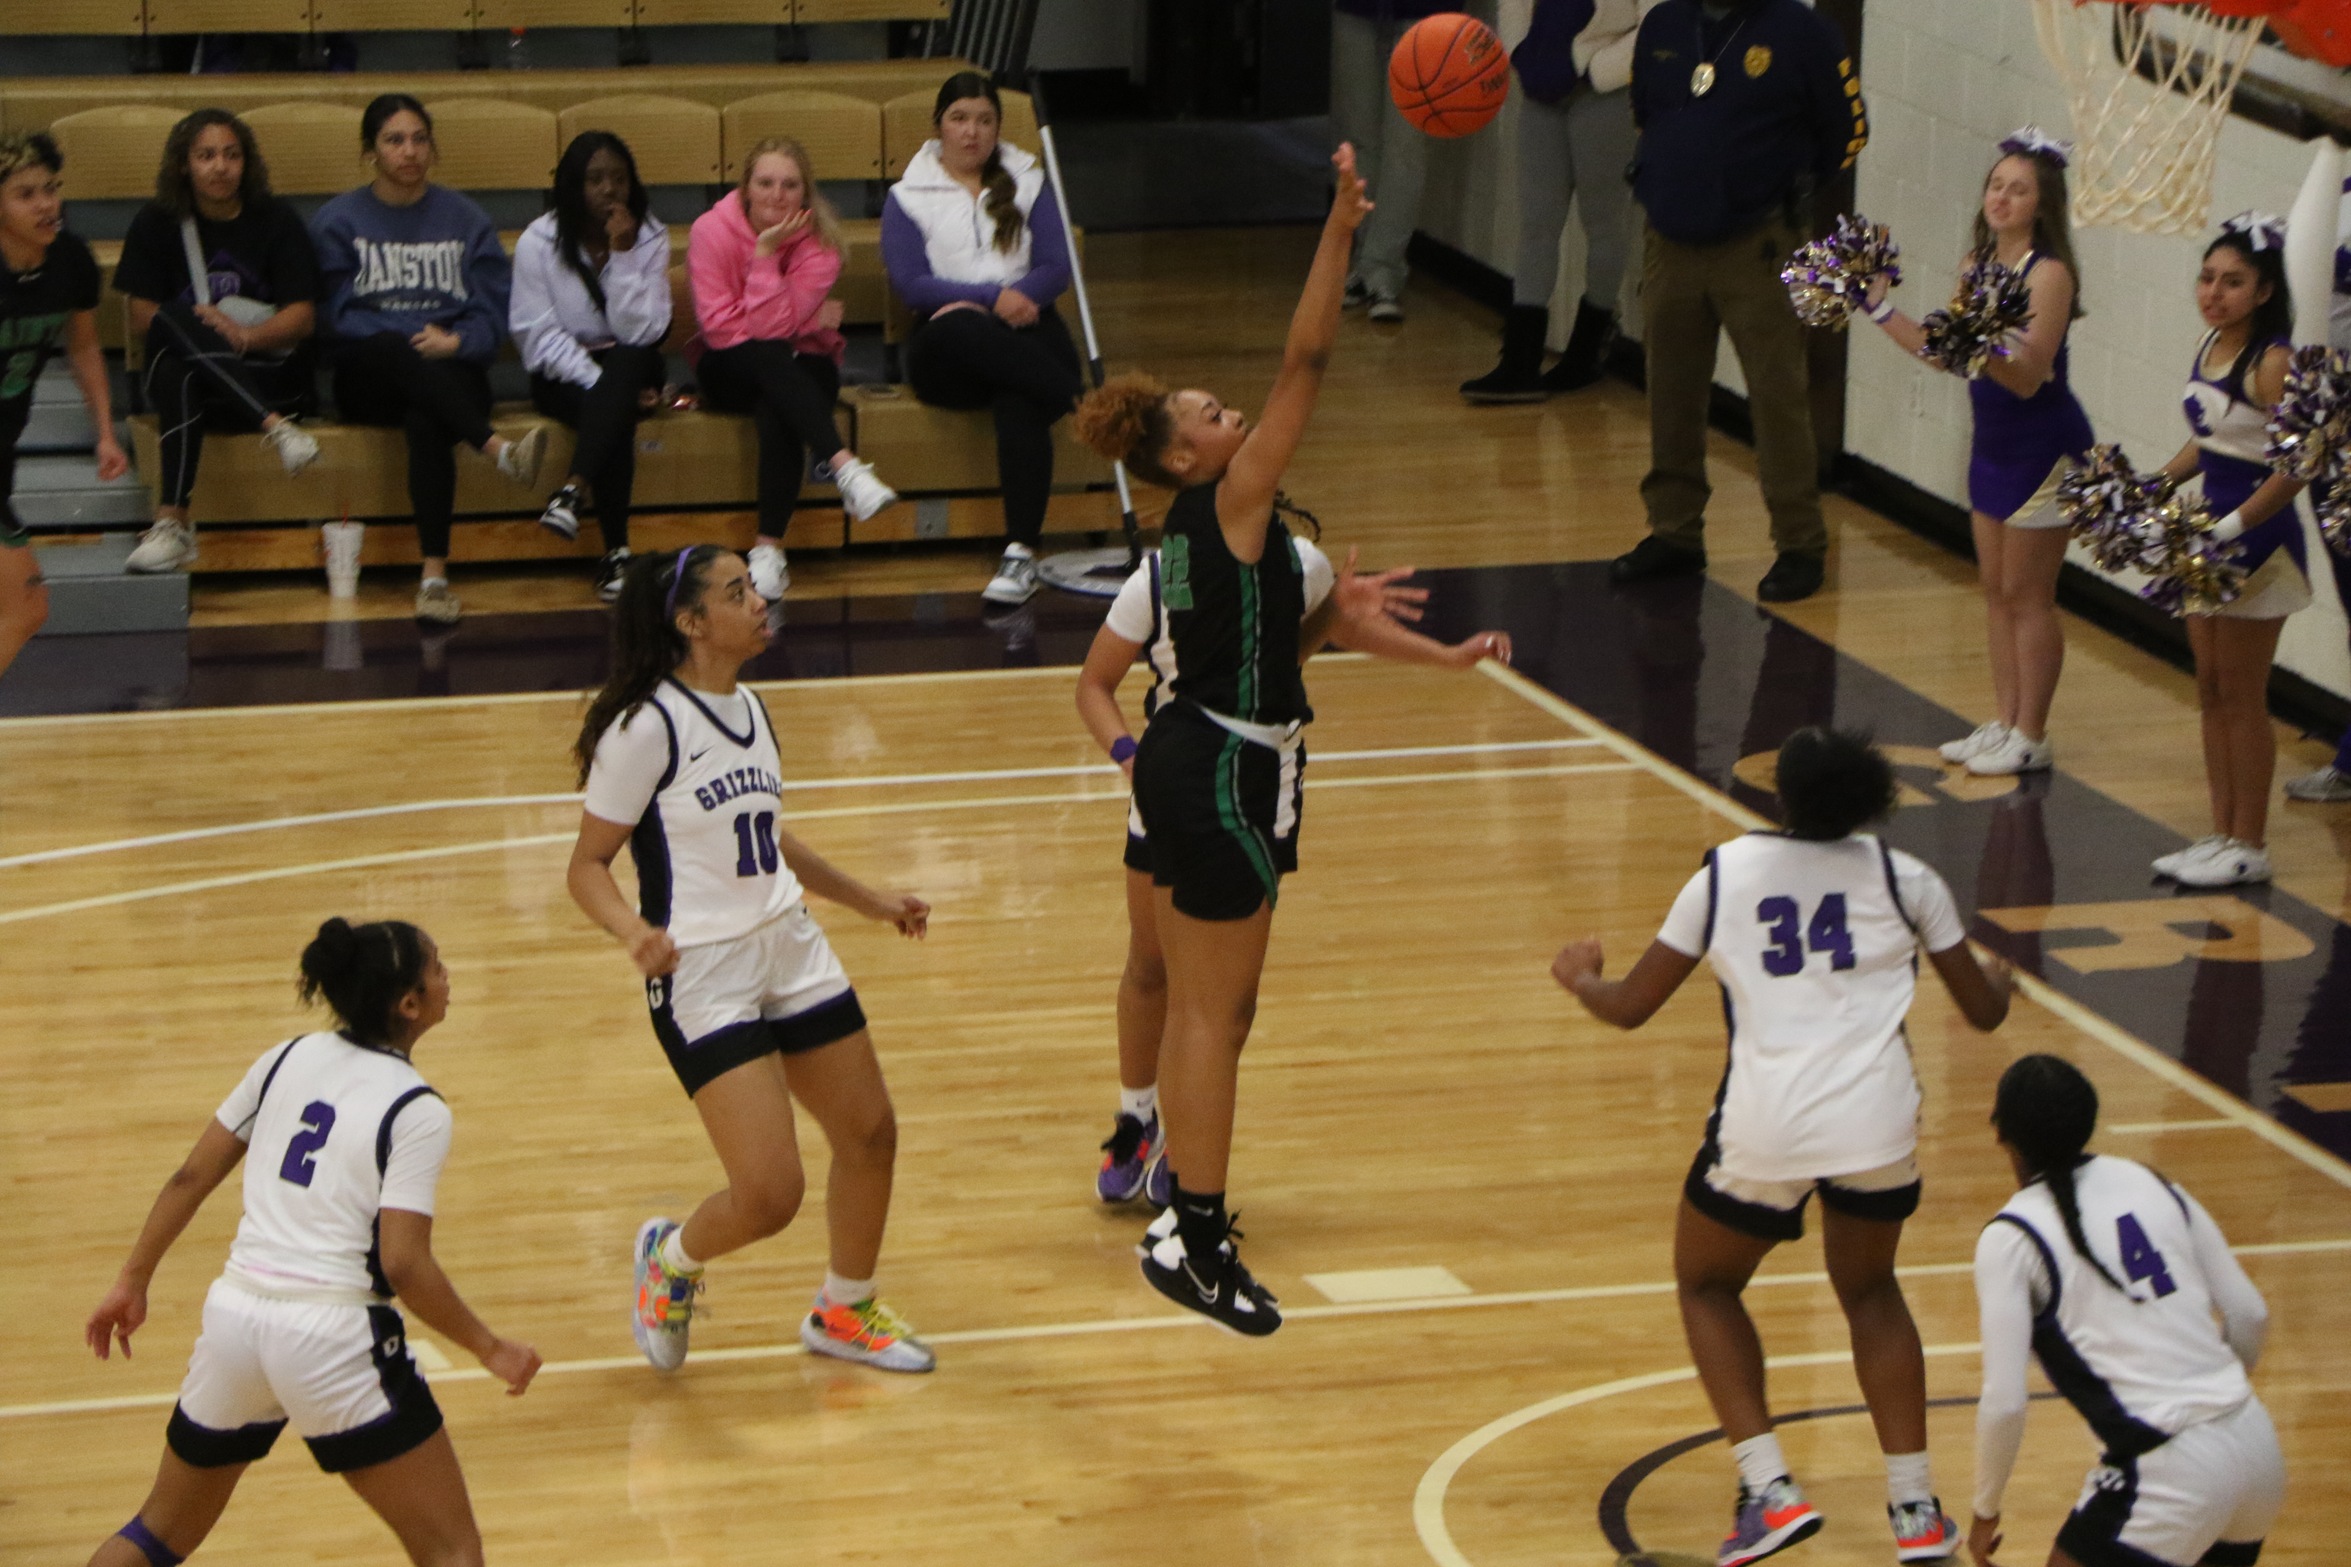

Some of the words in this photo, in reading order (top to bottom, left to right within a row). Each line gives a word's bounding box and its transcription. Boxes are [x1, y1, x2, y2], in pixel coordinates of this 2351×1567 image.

[734, 811, 778, 877] 10
[1757, 892, 1857, 977] 34
[279, 1099, 336, 1188] 2
[2115, 1211, 2177, 1299] 4
